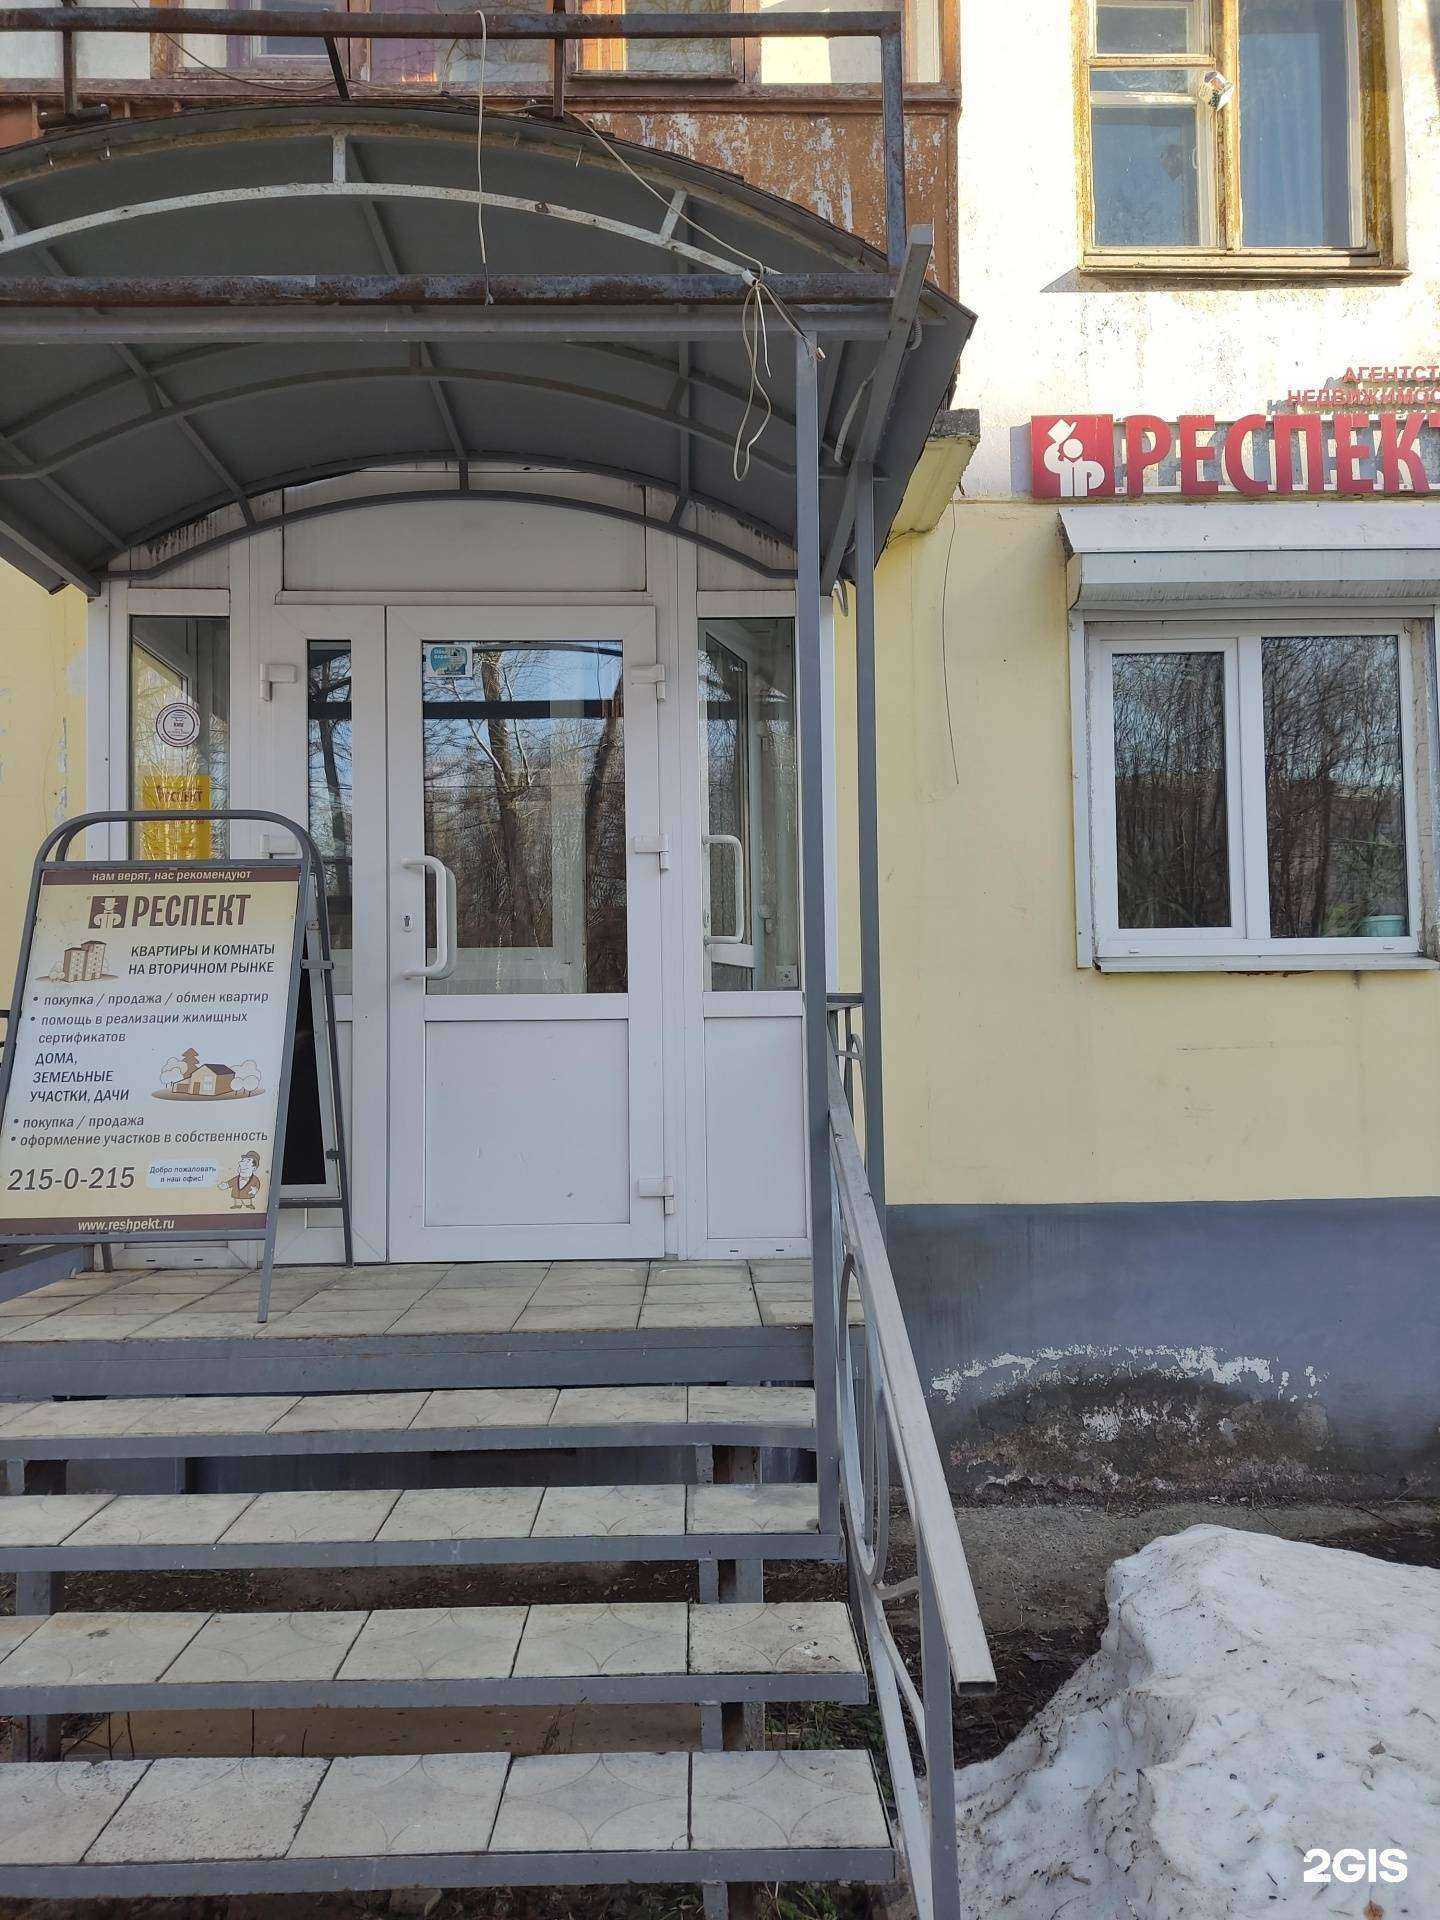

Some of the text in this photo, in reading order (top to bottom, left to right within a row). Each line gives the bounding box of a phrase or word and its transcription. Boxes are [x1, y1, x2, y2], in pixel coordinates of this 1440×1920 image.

[92, 870, 252, 882] нам верят, нас рекомендуют
[131, 894, 251, 927] РЕСПЕКТ
[131, 944, 275, 957] КВАРТИРЫ И КОМНАТЫ
[128, 961, 275, 975] НА ВТОРИЧНОМ РЫНКЕ
[43, 995, 94, 1006] покупка
[107, 994, 162, 1005] продажа
[175, 993, 216, 1003] обмен
[218, 992, 269, 1003] квартир
[41, 1013, 248, 1026] помощь в реализации жилищных
[38, 1032, 126, 1044] сертификатов
[35, 1053, 78, 1065] ДОМА,
[33, 1071, 114, 1084] ЗЕМЕЛЬНЫЕ
[30, 1089, 130, 1102] УЧАСТКИ, ДАЧИ
[23, 1118, 74, 1130] покупка
[88, 1117, 144, 1128] продажа
[20, 1131, 268, 1147] оформление участков в собственность
[6, 1167, 135, 1192] 215-0-215
[77, 1218, 175, 1232] www.reshpekt.ru
